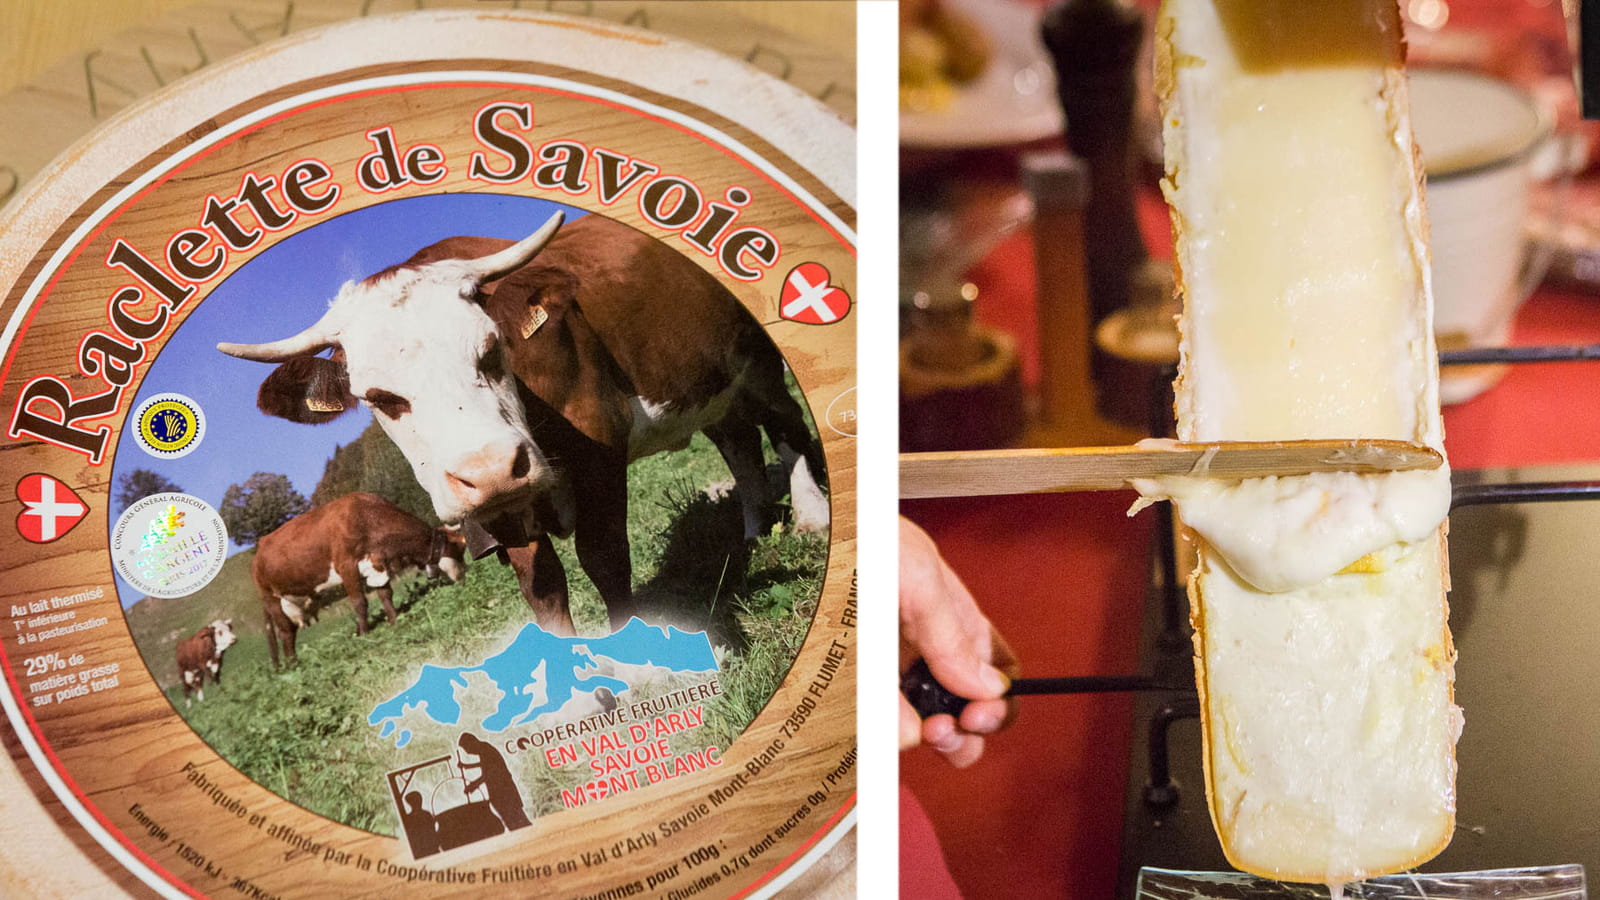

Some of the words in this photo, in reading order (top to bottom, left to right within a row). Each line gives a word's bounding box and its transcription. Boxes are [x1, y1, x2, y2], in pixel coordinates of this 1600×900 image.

[10, 159, 339, 464] Raclette
[359, 127, 446, 190] de
[471, 102, 779, 281] Savoie
[114, 510, 135, 550] CONCOURS
[10, 604, 28, 618] Au
[28, 598, 50, 614] lait
[50, 586, 105, 609] thermisé
[28, 610, 76, 629] inférieure
[17, 633, 26, 645] à
[26, 632, 37, 643] la
[38, 616, 109, 642] pasteurisation
[23, 651, 67, 678] 29%
[68, 653, 85, 666] de
[29, 671, 76, 694] matière
[78, 662, 121, 683] grasse
[32, 692, 53, 707] sur
[56, 682, 90, 704] poids
[90, 674, 120, 692] total
[630, 680, 724, 719] FRUITIERE
[180, 761, 248, 818] Fabriquée
[249, 811, 267, 829] et
[267, 821, 321, 856] affinée
[323, 846, 353, 865] par
[355, 853, 372, 871] la
[376, 857, 477, 884] Coopérative
[482, 864, 552, 884] Fruitière
[557, 859, 578, 874] en
[580, 848, 608, 868] Val
[611, 830, 658, 860] d'Arly
[658, 802, 711, 838] Savoie
[707, 738, 786, 807] Mont-Blanc
[778, 696, 817, 739] 73590
[808, 639, 848, 698] FLUMET
[840, 568, 857, 629] FRAN
[545, 743, 578, 768] EN
[580, 730, 627, 757] VAL
[629, 706, 704, 744] D'ARLY
[590, 738, 673, 778] SAVOIE
[646, 746, 722, 784] BLANC
[127, 802, 169, 843] Energie
[175, 842, 205, 868] 1520
[204, 860, 222, 878] kJ
[667, 872, 721, 900] Glucides
[720, 851, 750, 878] 0,7g
[749, 833, 777, 859] dont
[774, 802, 812, 839] sucres
[808, 789, 828, 807] 0g
[569, 881, 644, 900] yennes
[645, 862, 680, 891] pour
[681, 842, 720, 871] 100g
